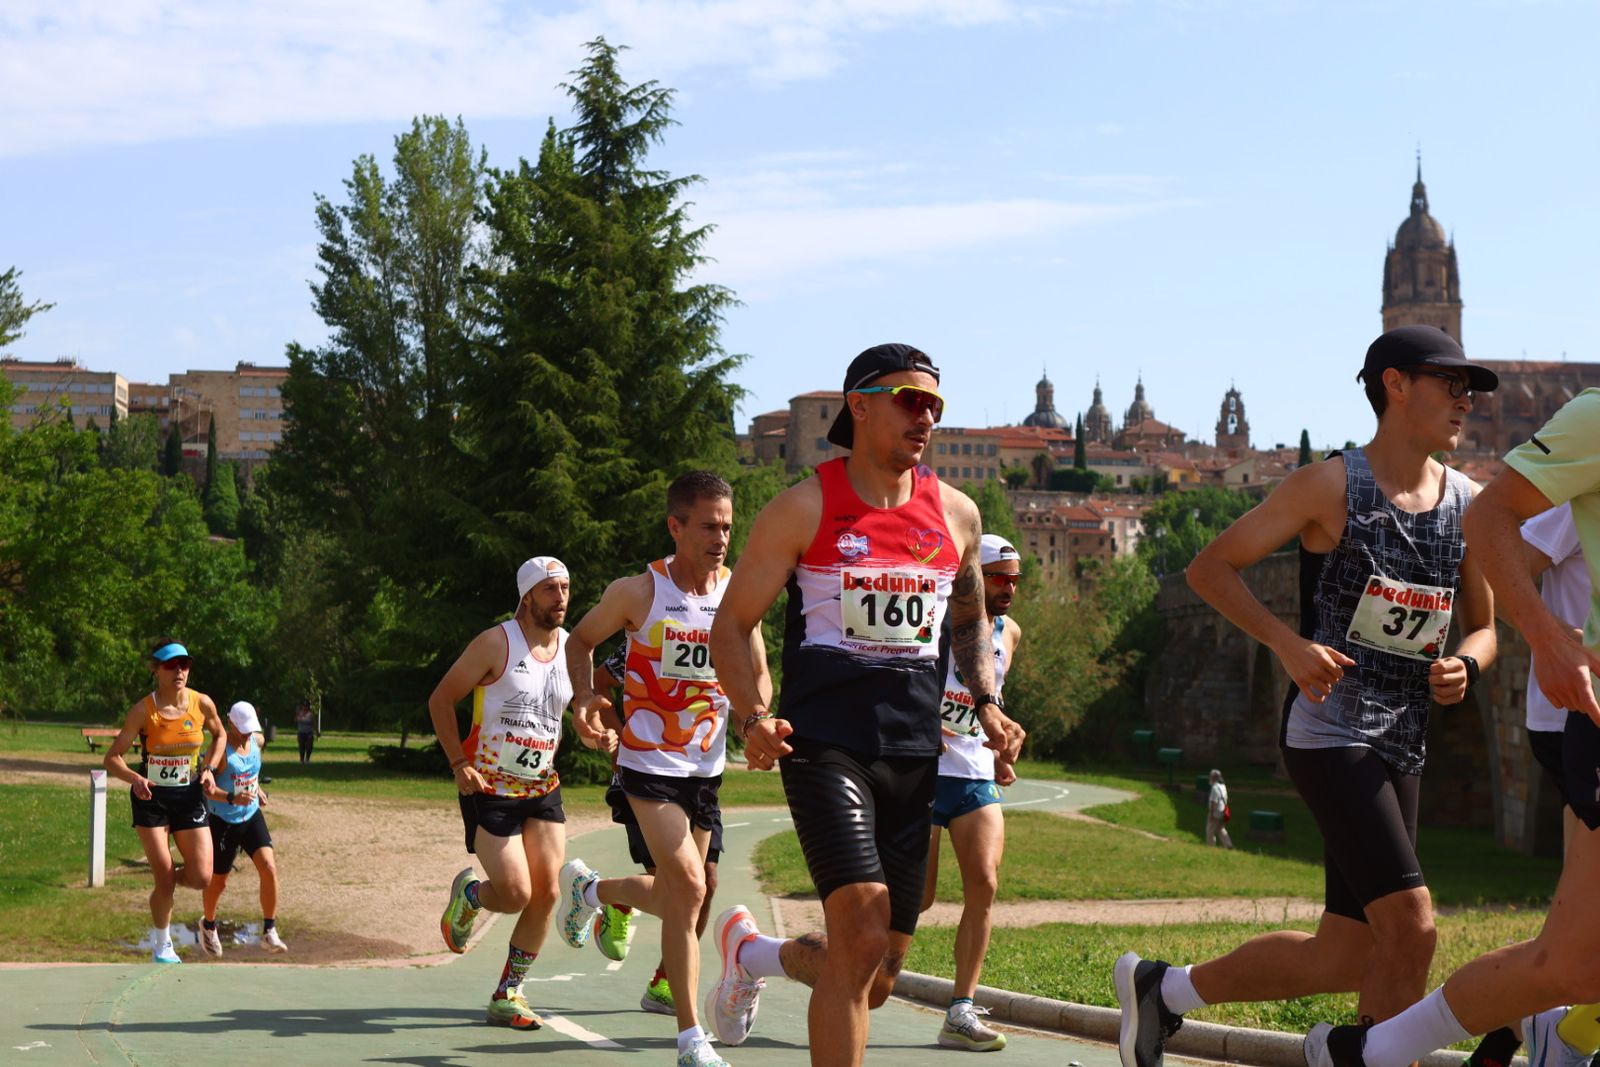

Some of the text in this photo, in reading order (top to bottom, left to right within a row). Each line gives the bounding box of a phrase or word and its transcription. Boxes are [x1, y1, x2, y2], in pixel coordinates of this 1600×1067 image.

[843, 572, 936, 594] bedunia
[1366, 583, 1451, 612] bedunia
[665, 604, 688, 613] RAMÓN
[861, 593, 923, 628] 160
[1382, 606, 1430, 641] 37
[665, 626, 709, 644] bedu
[674, 644, 714, 669] 20
[941, 700, 976, 727] 271
[505, 734, 555, 751] bedunia
[149, 757, 189, 767] bedunia
[515, 748, 542, 769] 43
[160, 766, 179, 780] 64
